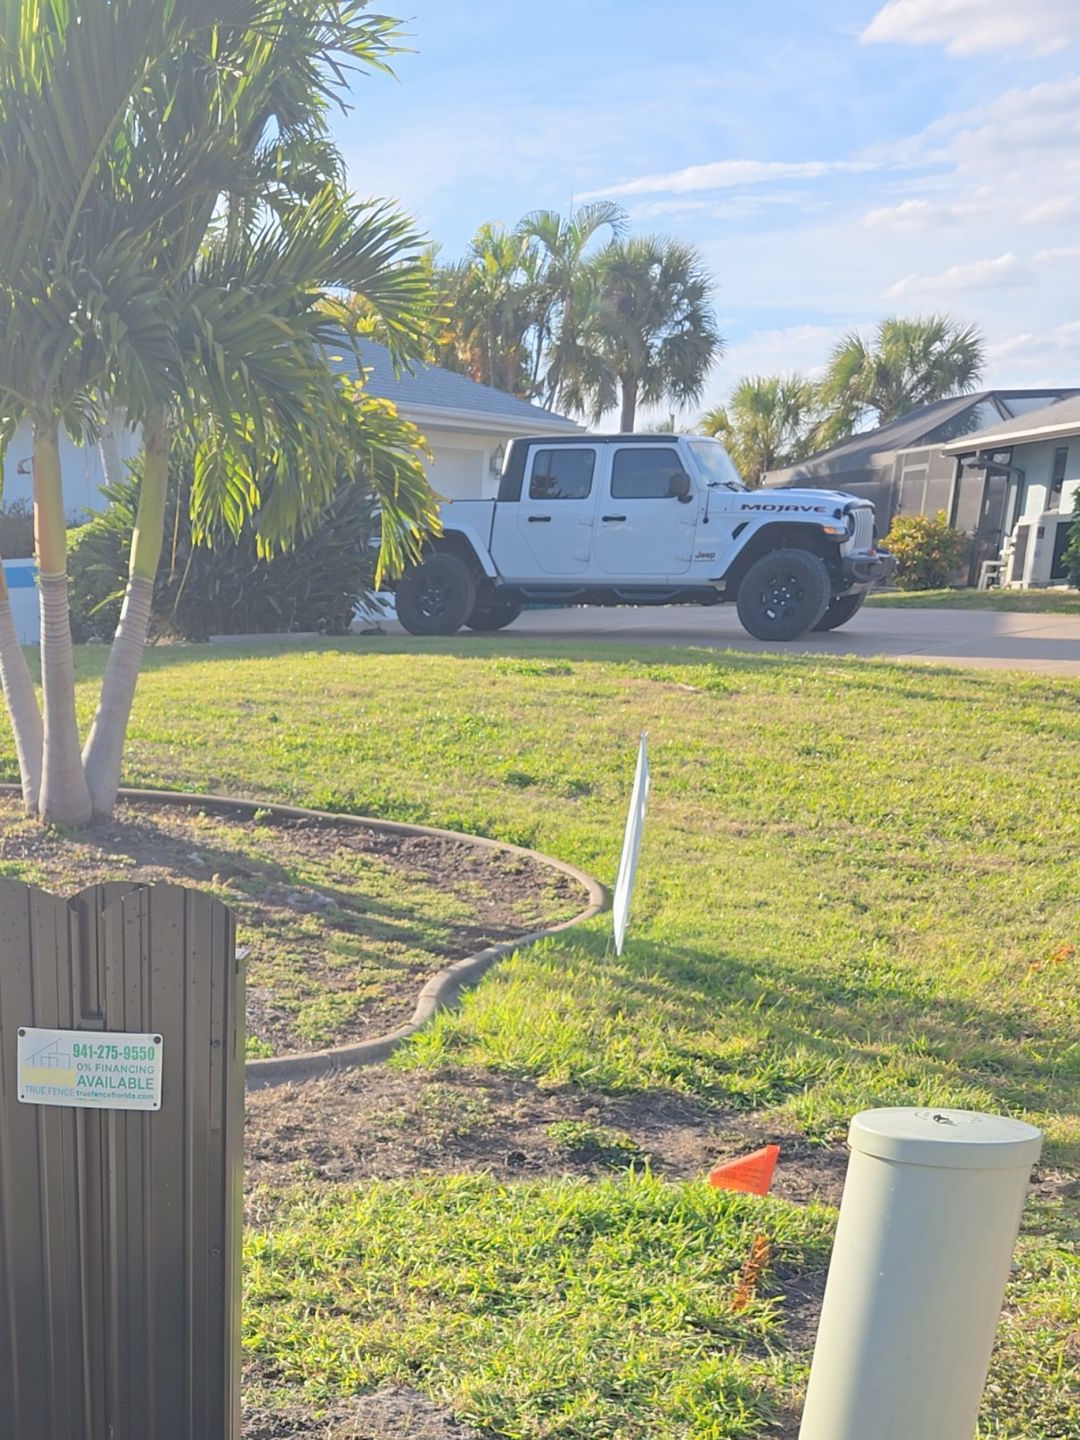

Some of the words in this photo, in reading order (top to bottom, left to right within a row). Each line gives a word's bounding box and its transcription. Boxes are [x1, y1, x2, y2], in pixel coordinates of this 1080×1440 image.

[740, 503, 827, 513] MOJAVE
[695, 551, 716, 559] Jeep
[72, 1043, 156, 1061] 941-275-9550
[76, 1062, 92, 1072] 0%
[95, 1063, 155, 1074] FINANCING
[76, 1075, 155, 1090] AVAILABLE
[24, 1085, 46, 1095] TRUE
[47, 1086, 75, 1097] FENCE
